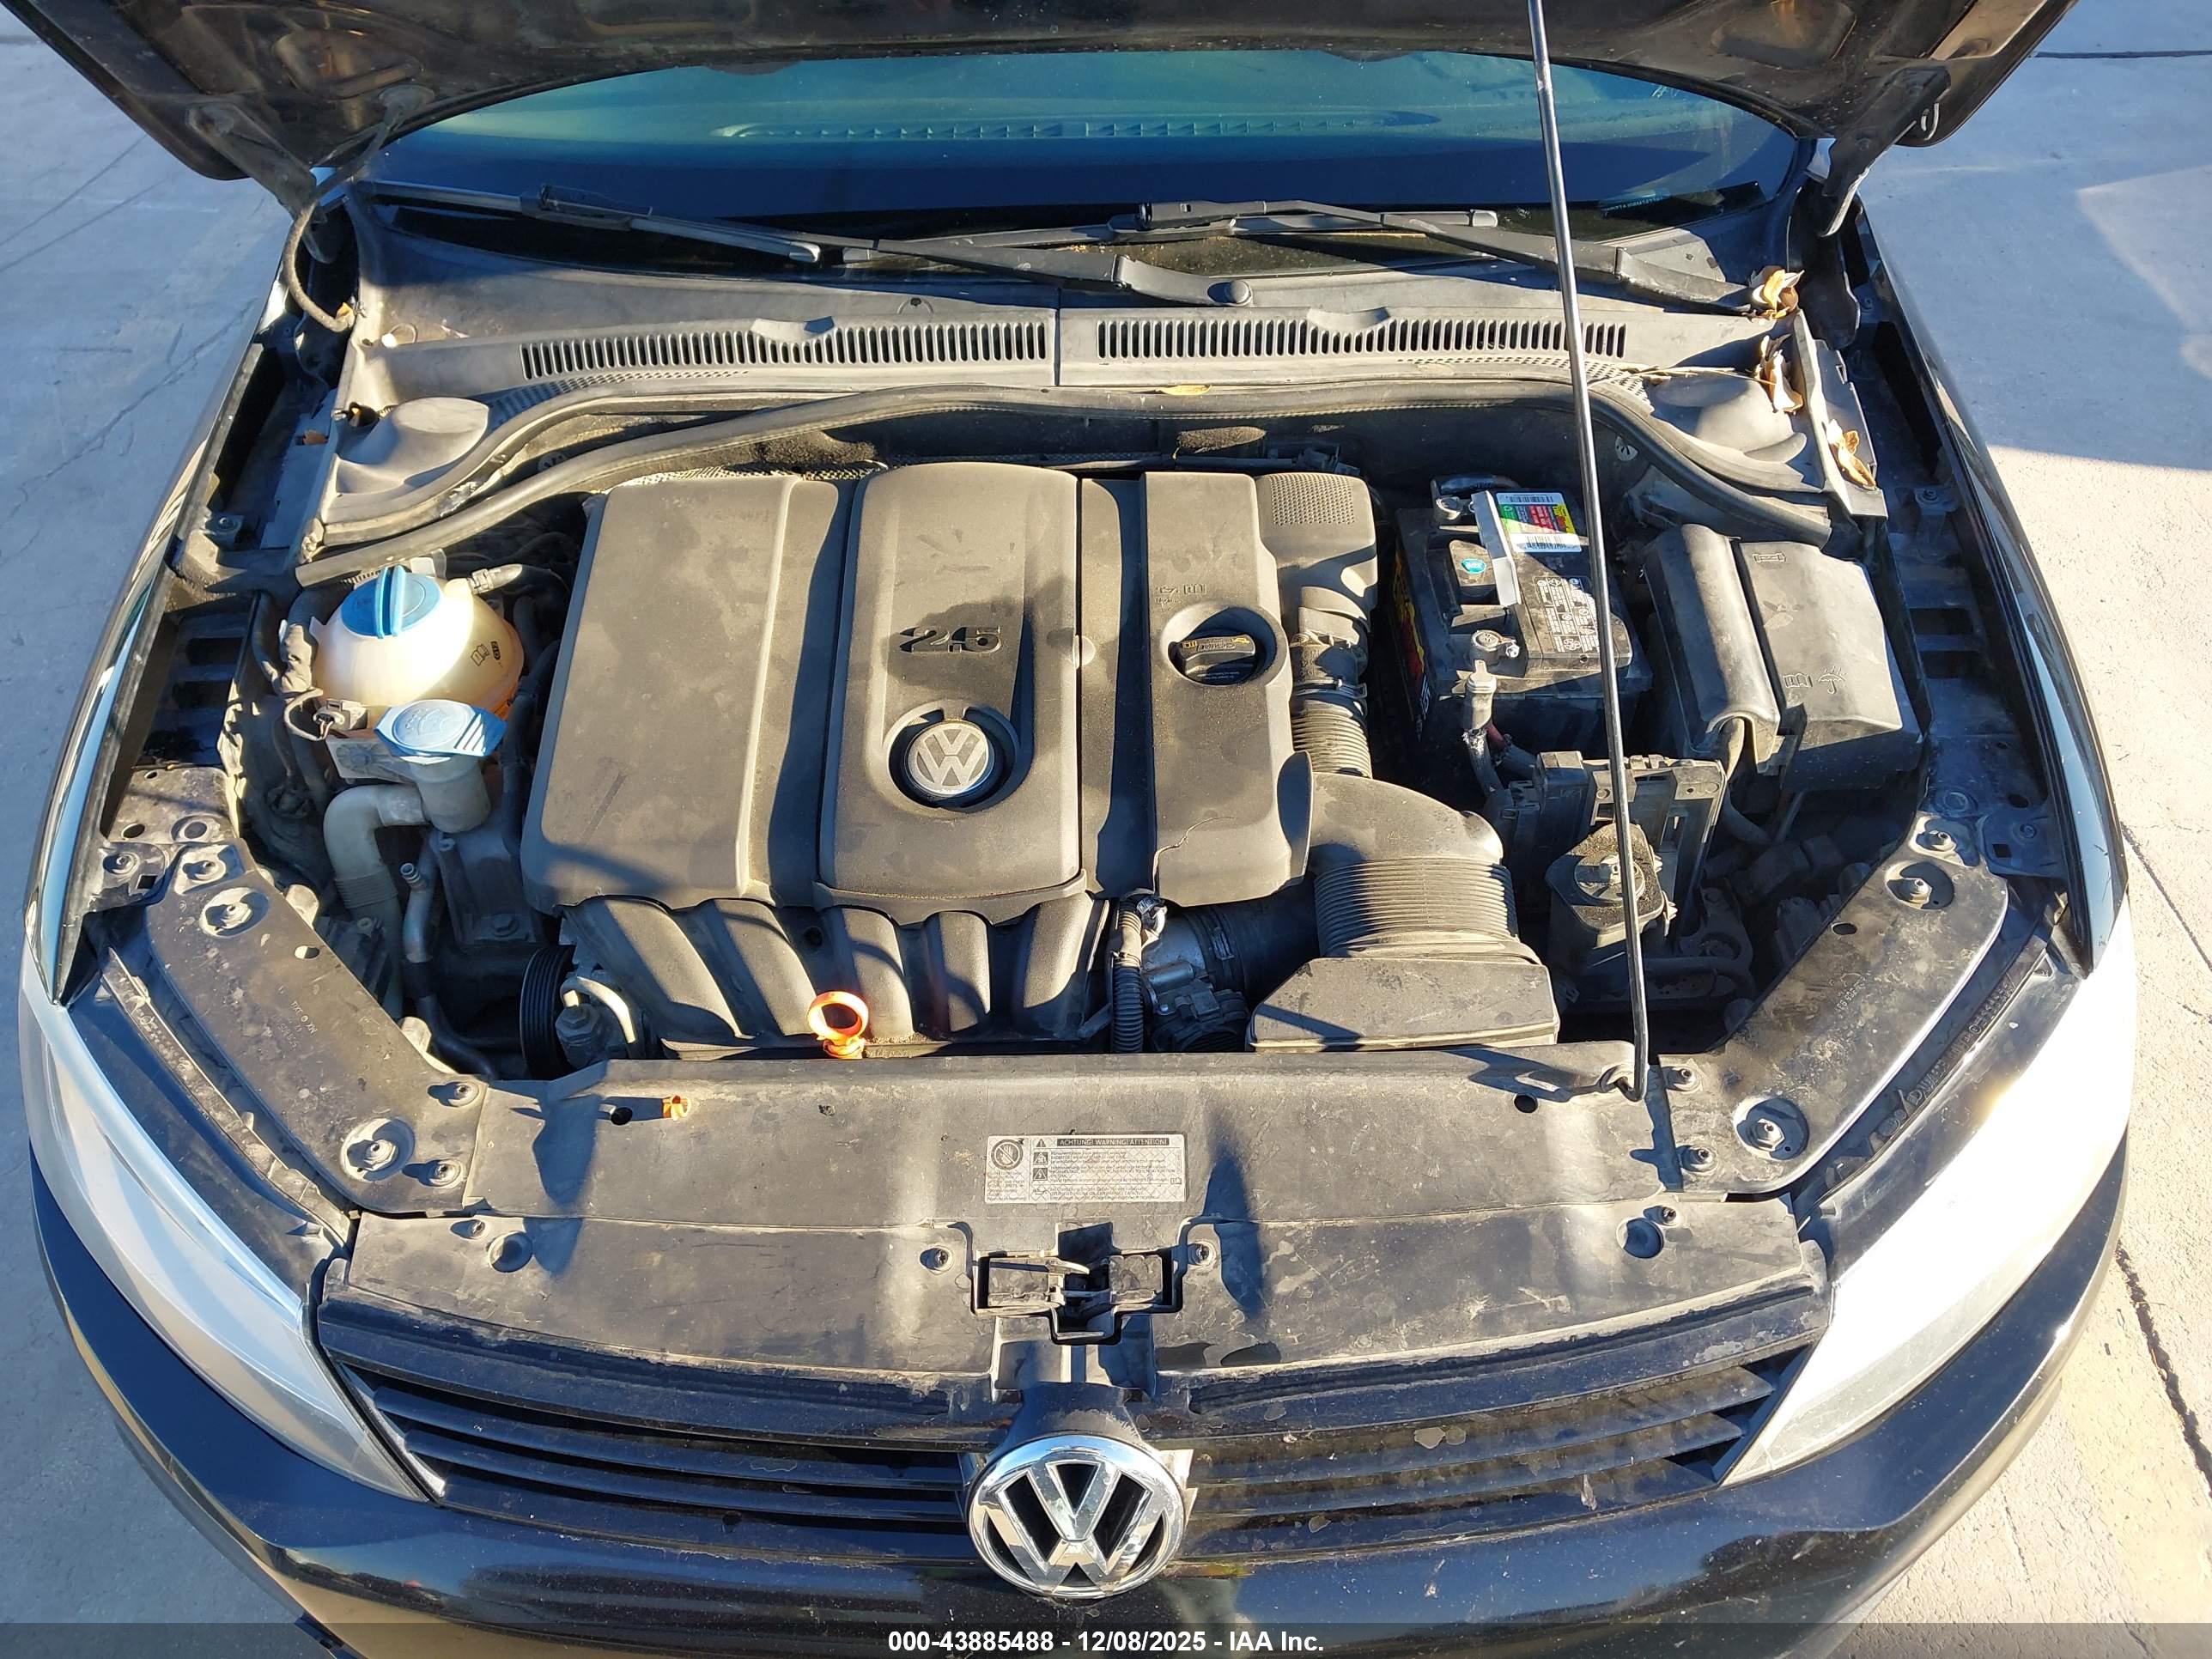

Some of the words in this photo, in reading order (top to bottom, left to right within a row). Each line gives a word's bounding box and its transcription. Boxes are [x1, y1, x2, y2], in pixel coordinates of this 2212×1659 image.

[900, 625, 1002, 653] 2.5
[908, 722, 989, 794] VW
[970, 1437, 1182, 1599] VW
